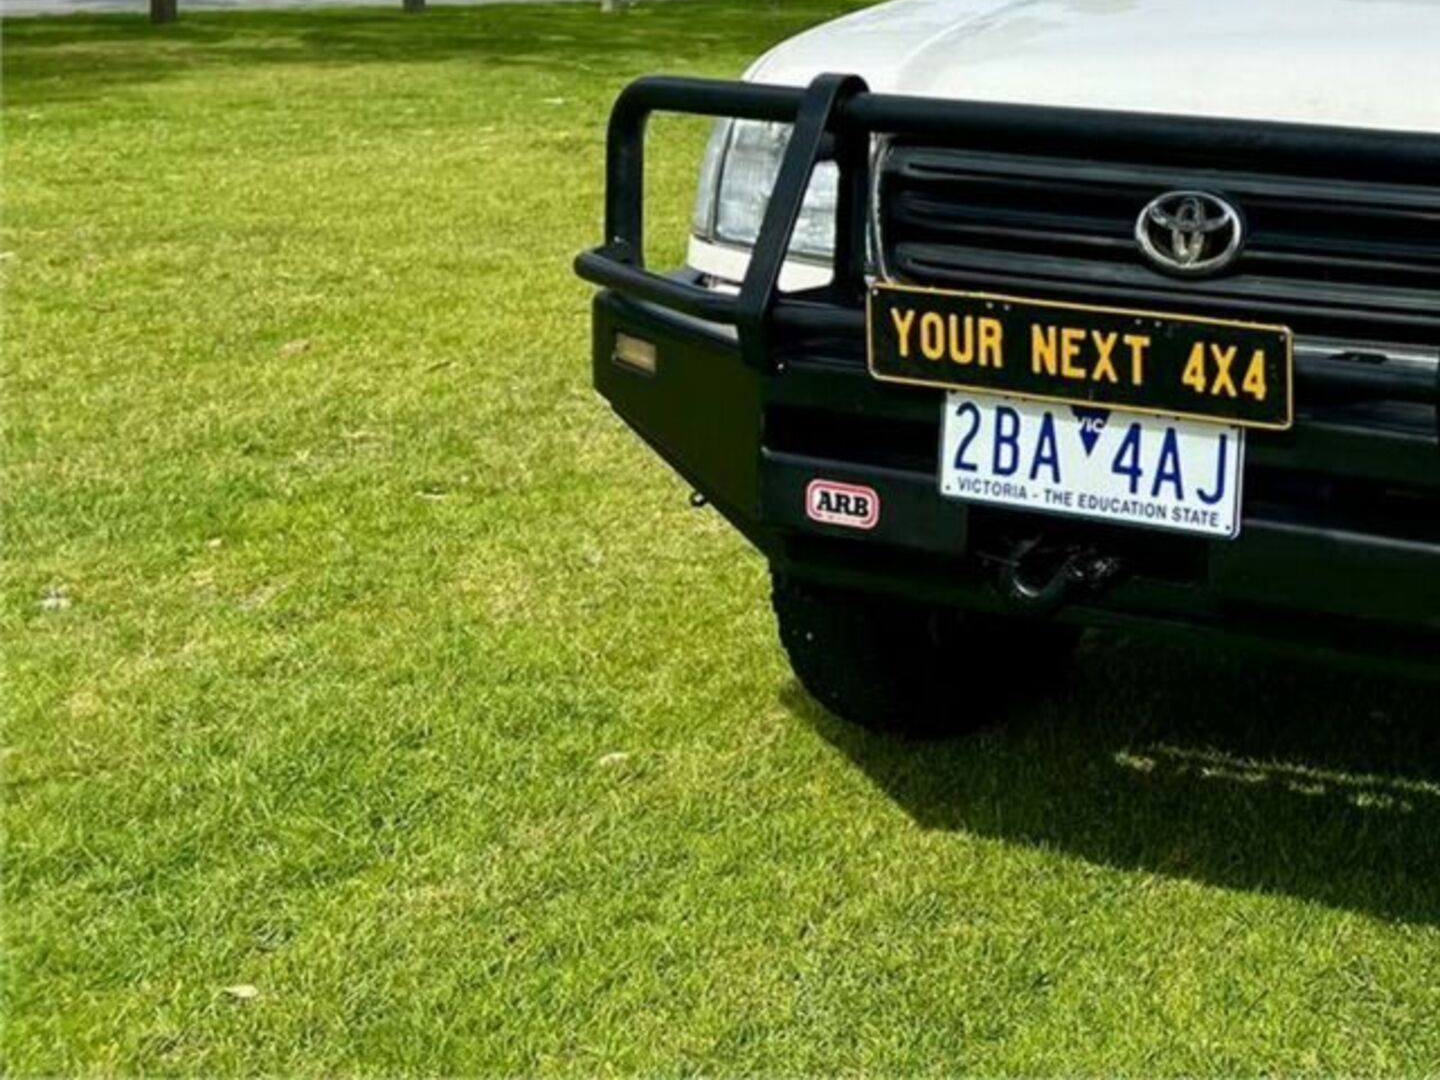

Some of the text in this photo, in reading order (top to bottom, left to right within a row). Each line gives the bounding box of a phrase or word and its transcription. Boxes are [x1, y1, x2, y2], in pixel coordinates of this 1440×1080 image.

[891, 307, 1267, 402] YOUR NEXT 4X4
[1077, 416, 1105, 434] VIC
[953, 401, 1228, 505] 2BA 4AJ
[816, 490, 869, 518] ARB
[956, 476, 1028, 500] VICTORIA
[1044, 488, 1073, 508] THE
[1077, 493, 1167, 520] EDUCATION
[1171, 507, 1220, 528] STATE
